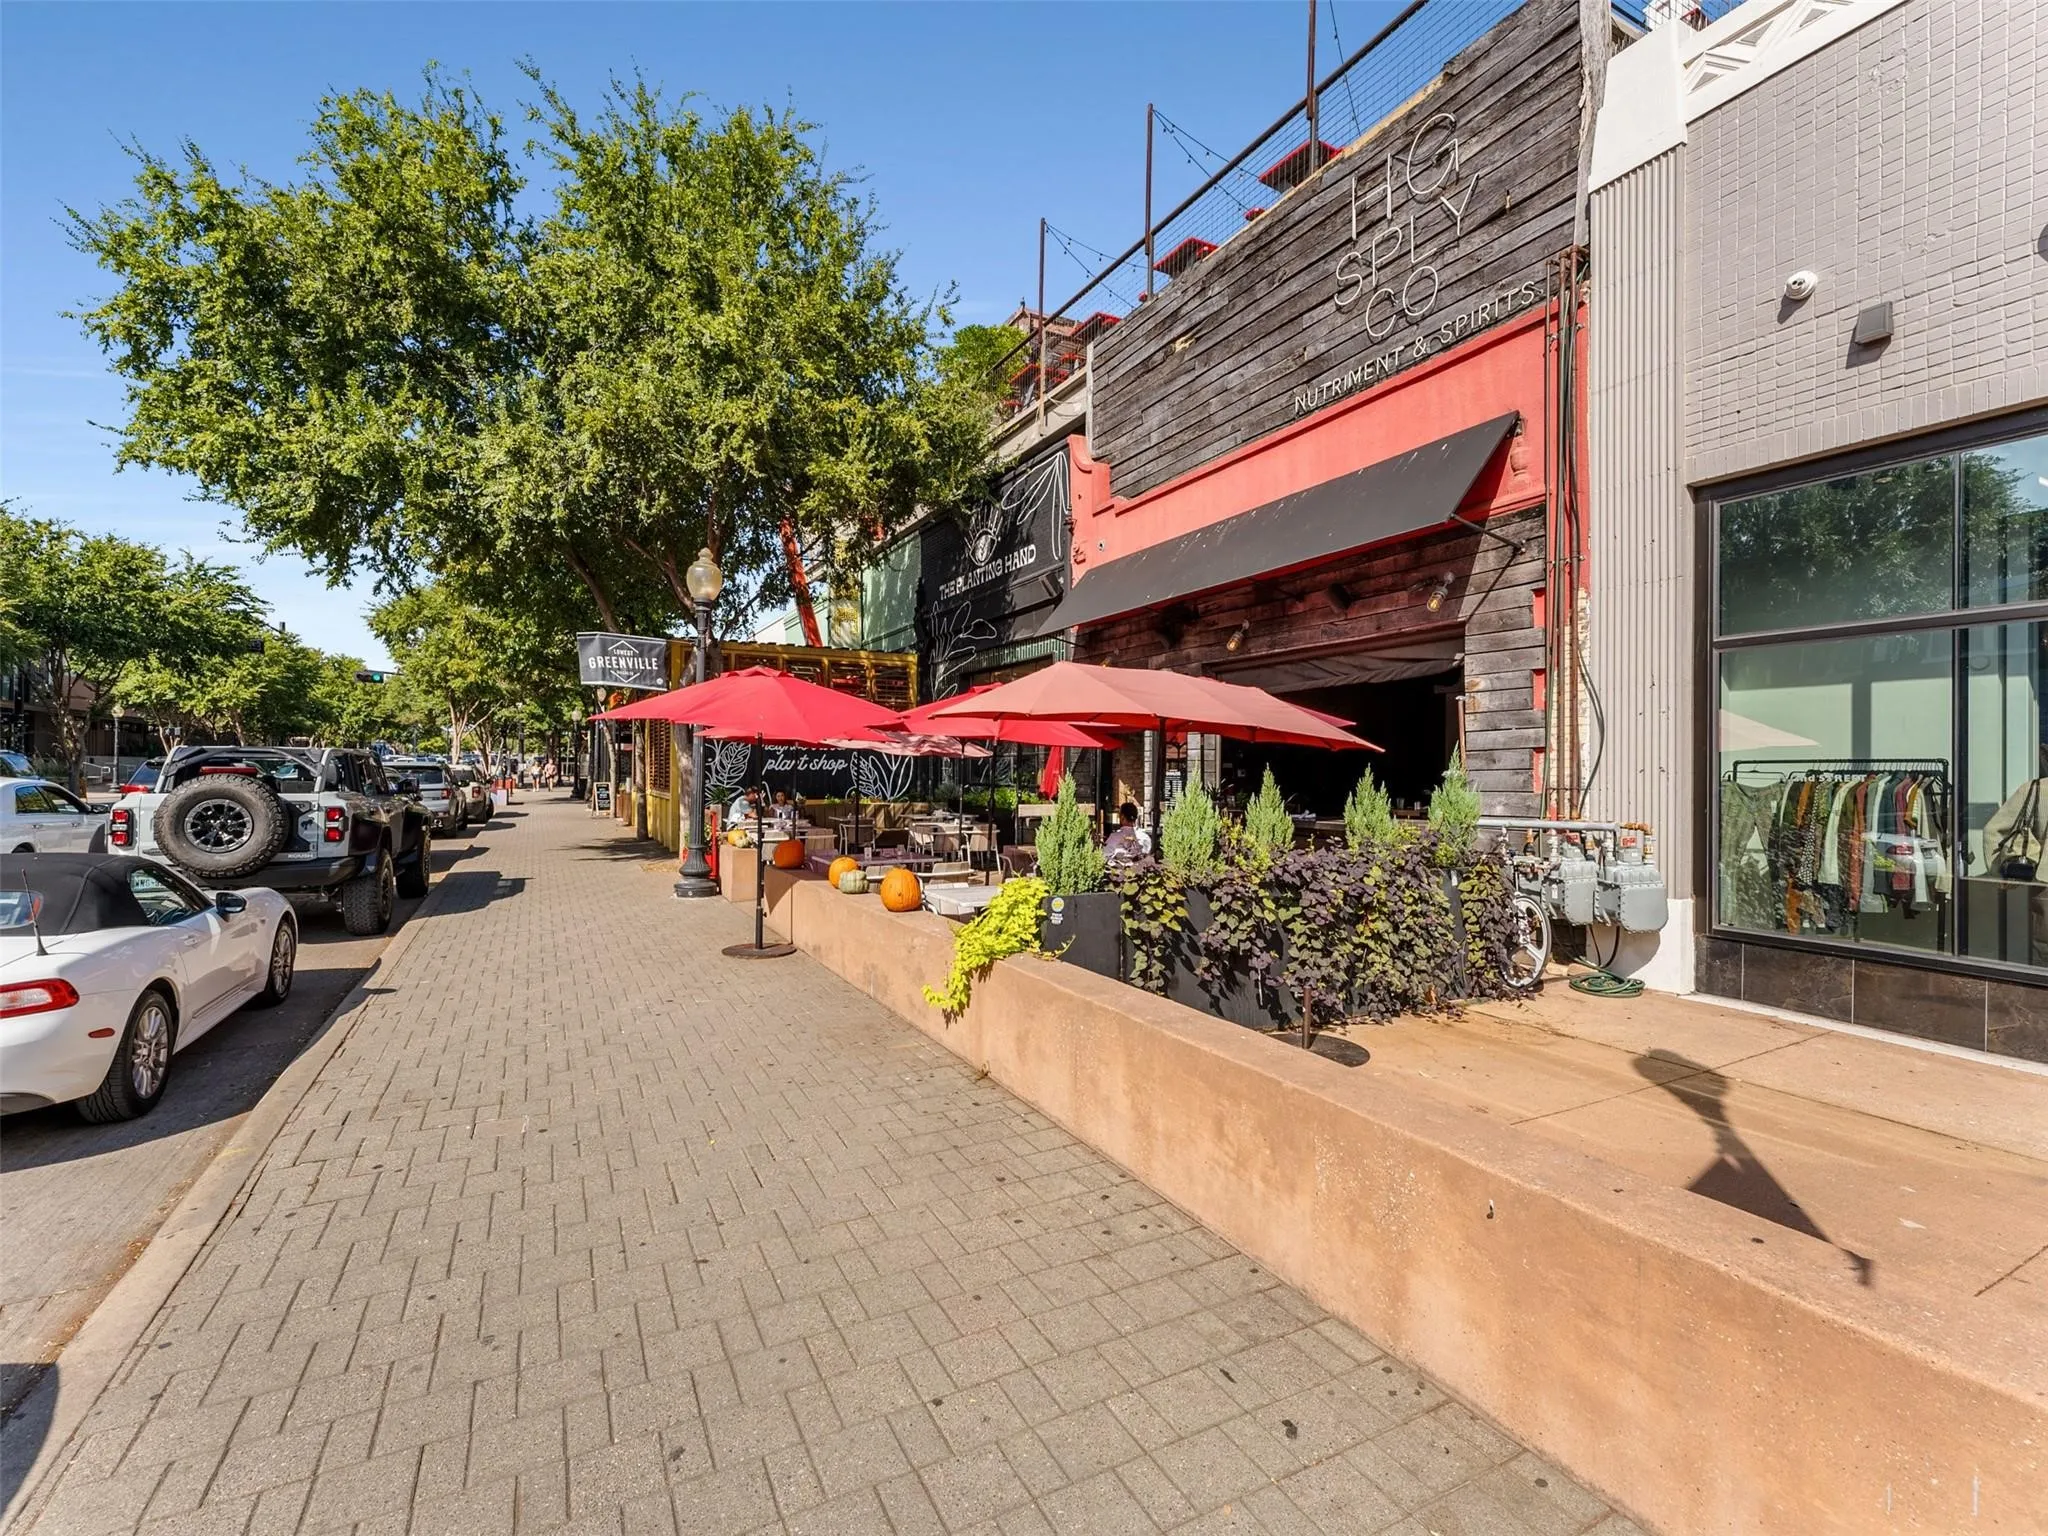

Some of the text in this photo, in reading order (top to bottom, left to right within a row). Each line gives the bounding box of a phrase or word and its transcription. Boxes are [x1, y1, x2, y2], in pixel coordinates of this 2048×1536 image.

[1351, 112, 1459, 241] HG
[1334, 171, 1481, 306] SPLY
[1365, 264, 1439, 337] CO
[1294, 280, 1536, 414] NUTRIMENT & SPIRITS
[938, 543, 1037, 601] THE PLANTING HAND
[588, 656, 659, 670] GREENVILLE
[809, 754, 848, 776] shop
